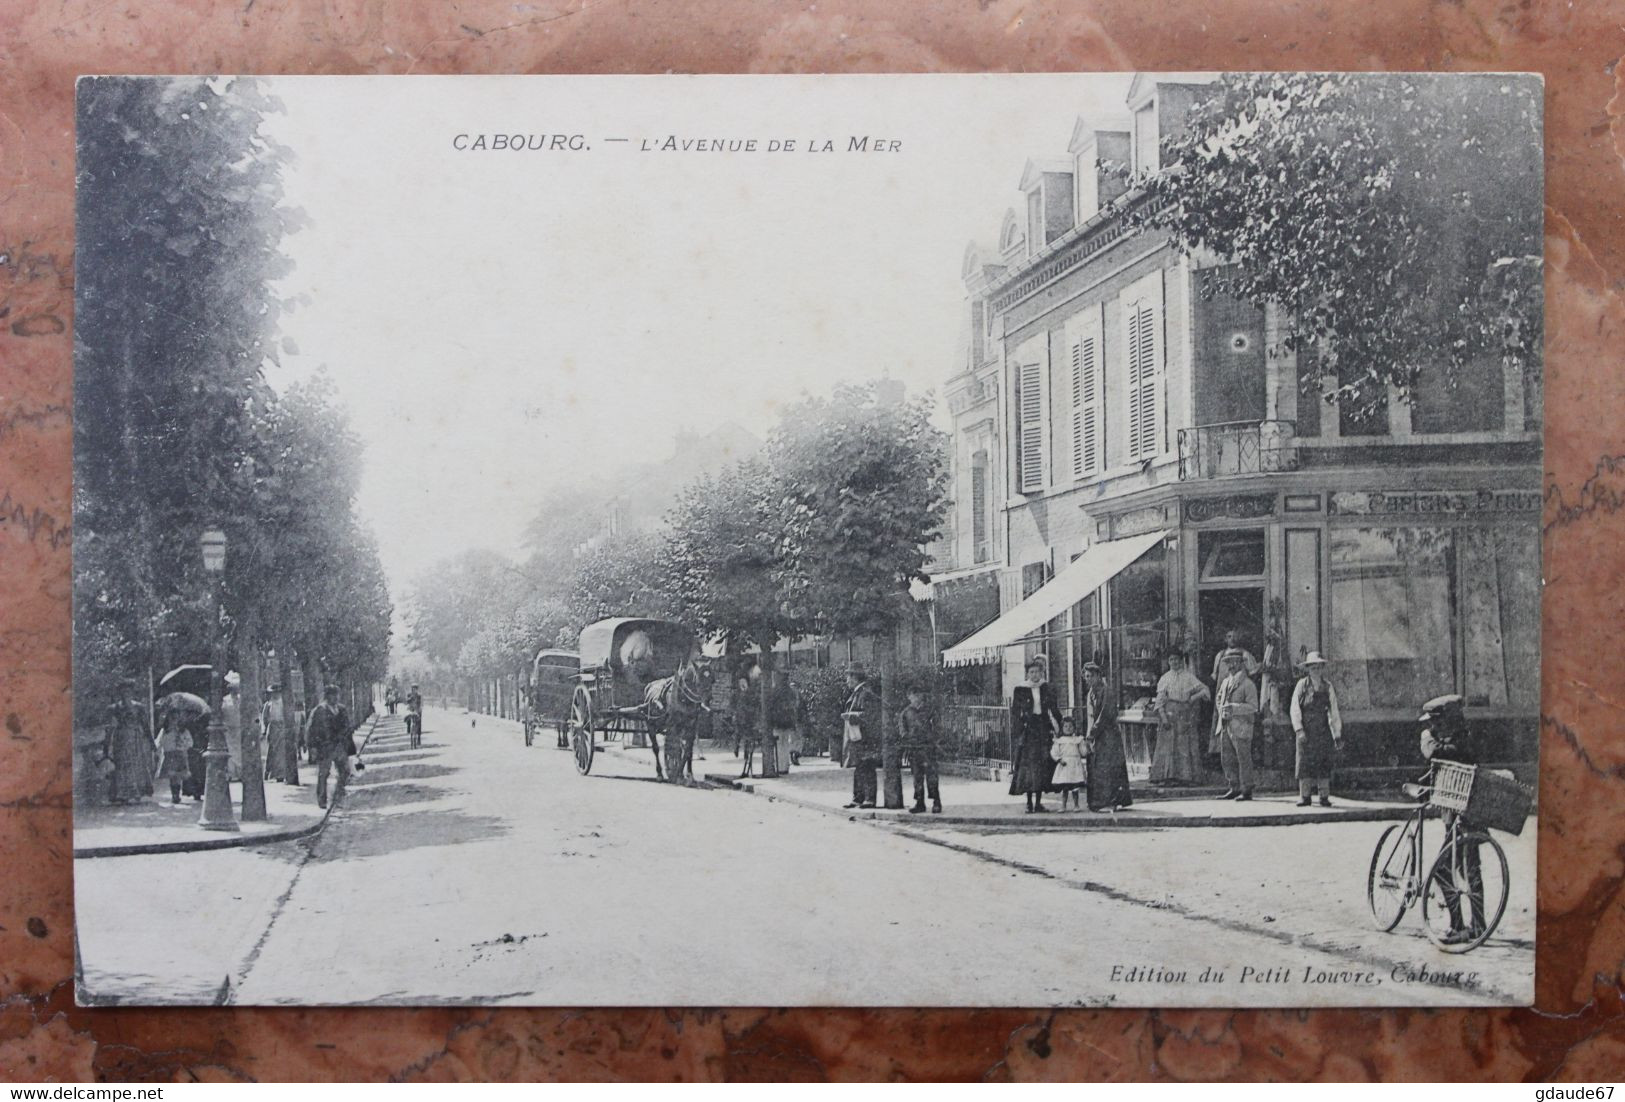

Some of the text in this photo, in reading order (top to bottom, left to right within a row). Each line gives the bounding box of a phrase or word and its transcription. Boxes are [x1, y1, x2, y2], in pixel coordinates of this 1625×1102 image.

[453, 134, 591, 151] CABOURG.
[1110, 965, 1188, 983] Edition
[1198, 966, 1225, 983] du
[1239, 966, 1291, 983] Petit
[1302, 966, 1382, 986] Louvre,
